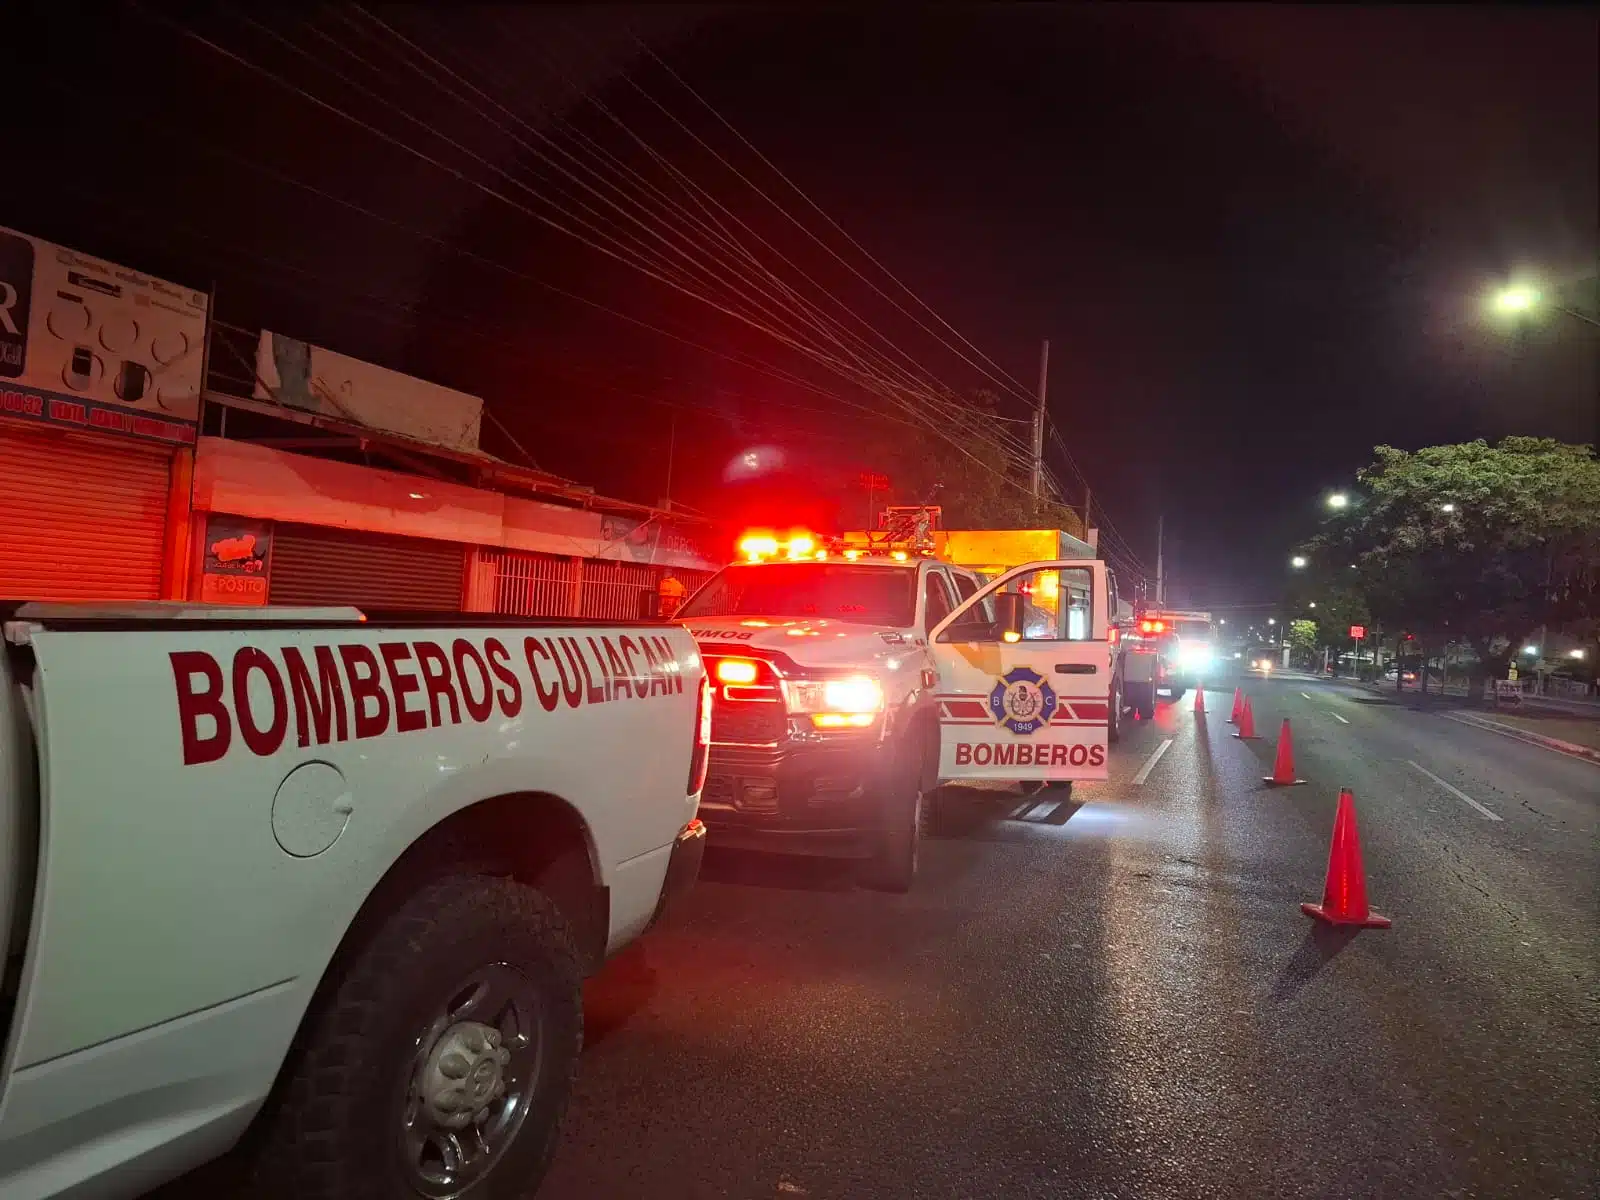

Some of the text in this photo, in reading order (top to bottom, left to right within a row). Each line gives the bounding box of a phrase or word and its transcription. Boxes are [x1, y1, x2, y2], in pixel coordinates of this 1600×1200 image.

[168, 635, 684, 765] BOMBEROS CULIACAN
[993, 696, 1053, 706] B C
[1013, 723, 1033, 732] 1949
[955, 742, 1105, 766] BOMBEROS
